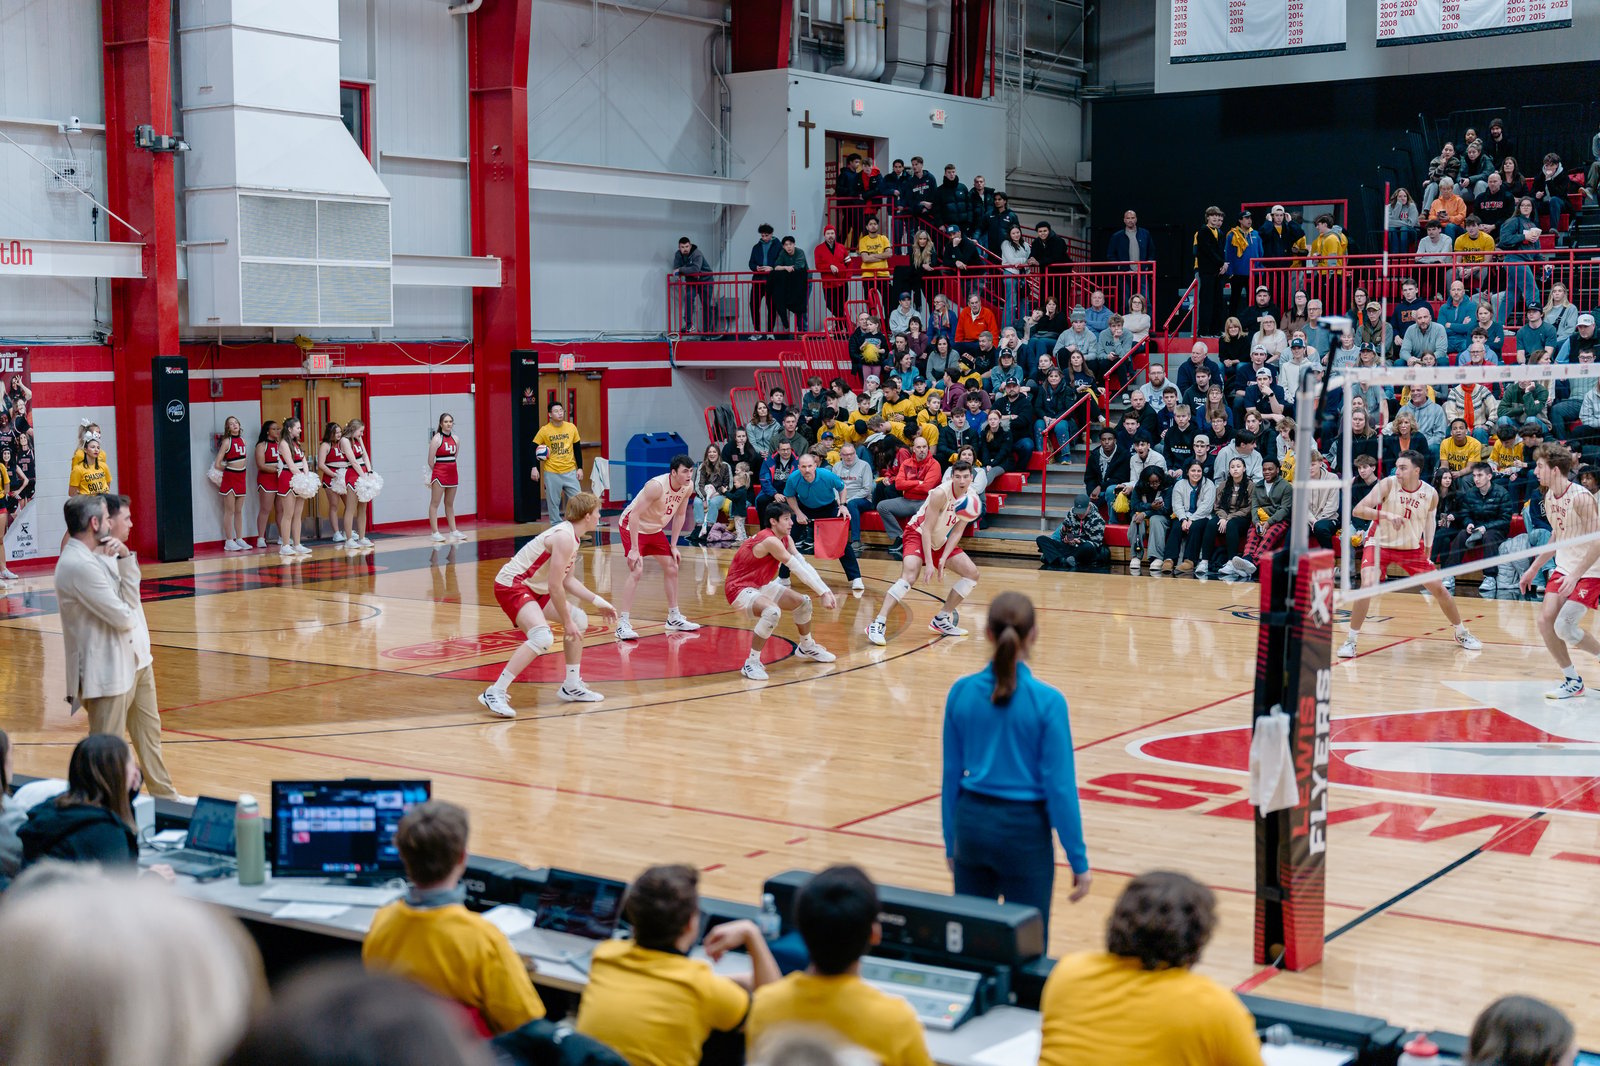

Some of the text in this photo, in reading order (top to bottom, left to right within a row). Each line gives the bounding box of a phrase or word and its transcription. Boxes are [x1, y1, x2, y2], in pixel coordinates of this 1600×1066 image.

[1551, 0, 1568, 8] 2023
[1507, 14, 1526, 22] 2007
[936, 110, 944, 120] EXIT
[313, 356, 326, 369] EXIT
[234, 443, 246, 456] LU
[444, 442, 456, 454] LU
[666, 506, 672, 514] 6
[1556, 517, 1565, 531] 2
[1292, 696, 1315, 838] LEWIS
[1309, 668, 1331, 856] FLYERS
